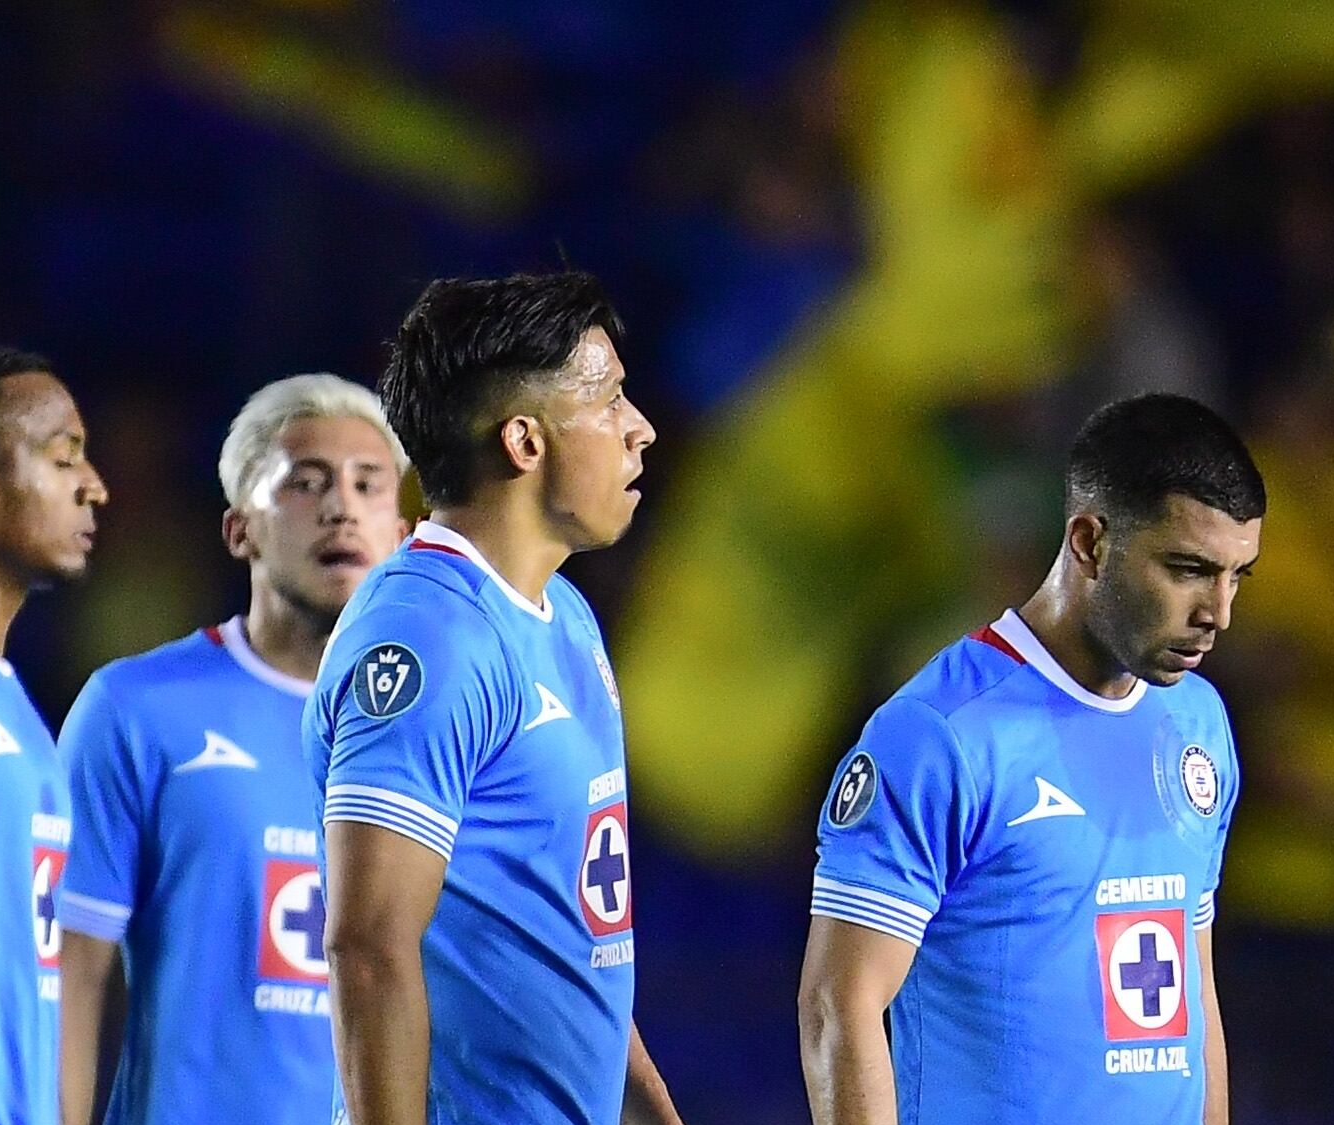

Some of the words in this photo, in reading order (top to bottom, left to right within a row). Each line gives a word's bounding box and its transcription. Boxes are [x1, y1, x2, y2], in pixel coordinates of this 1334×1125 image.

[1095, 873, 1186, 906] CEMENTO
[1105, 1048, 1157, 1075] CRUZ
[1156, 1045, 1190, 1072] AZUL
